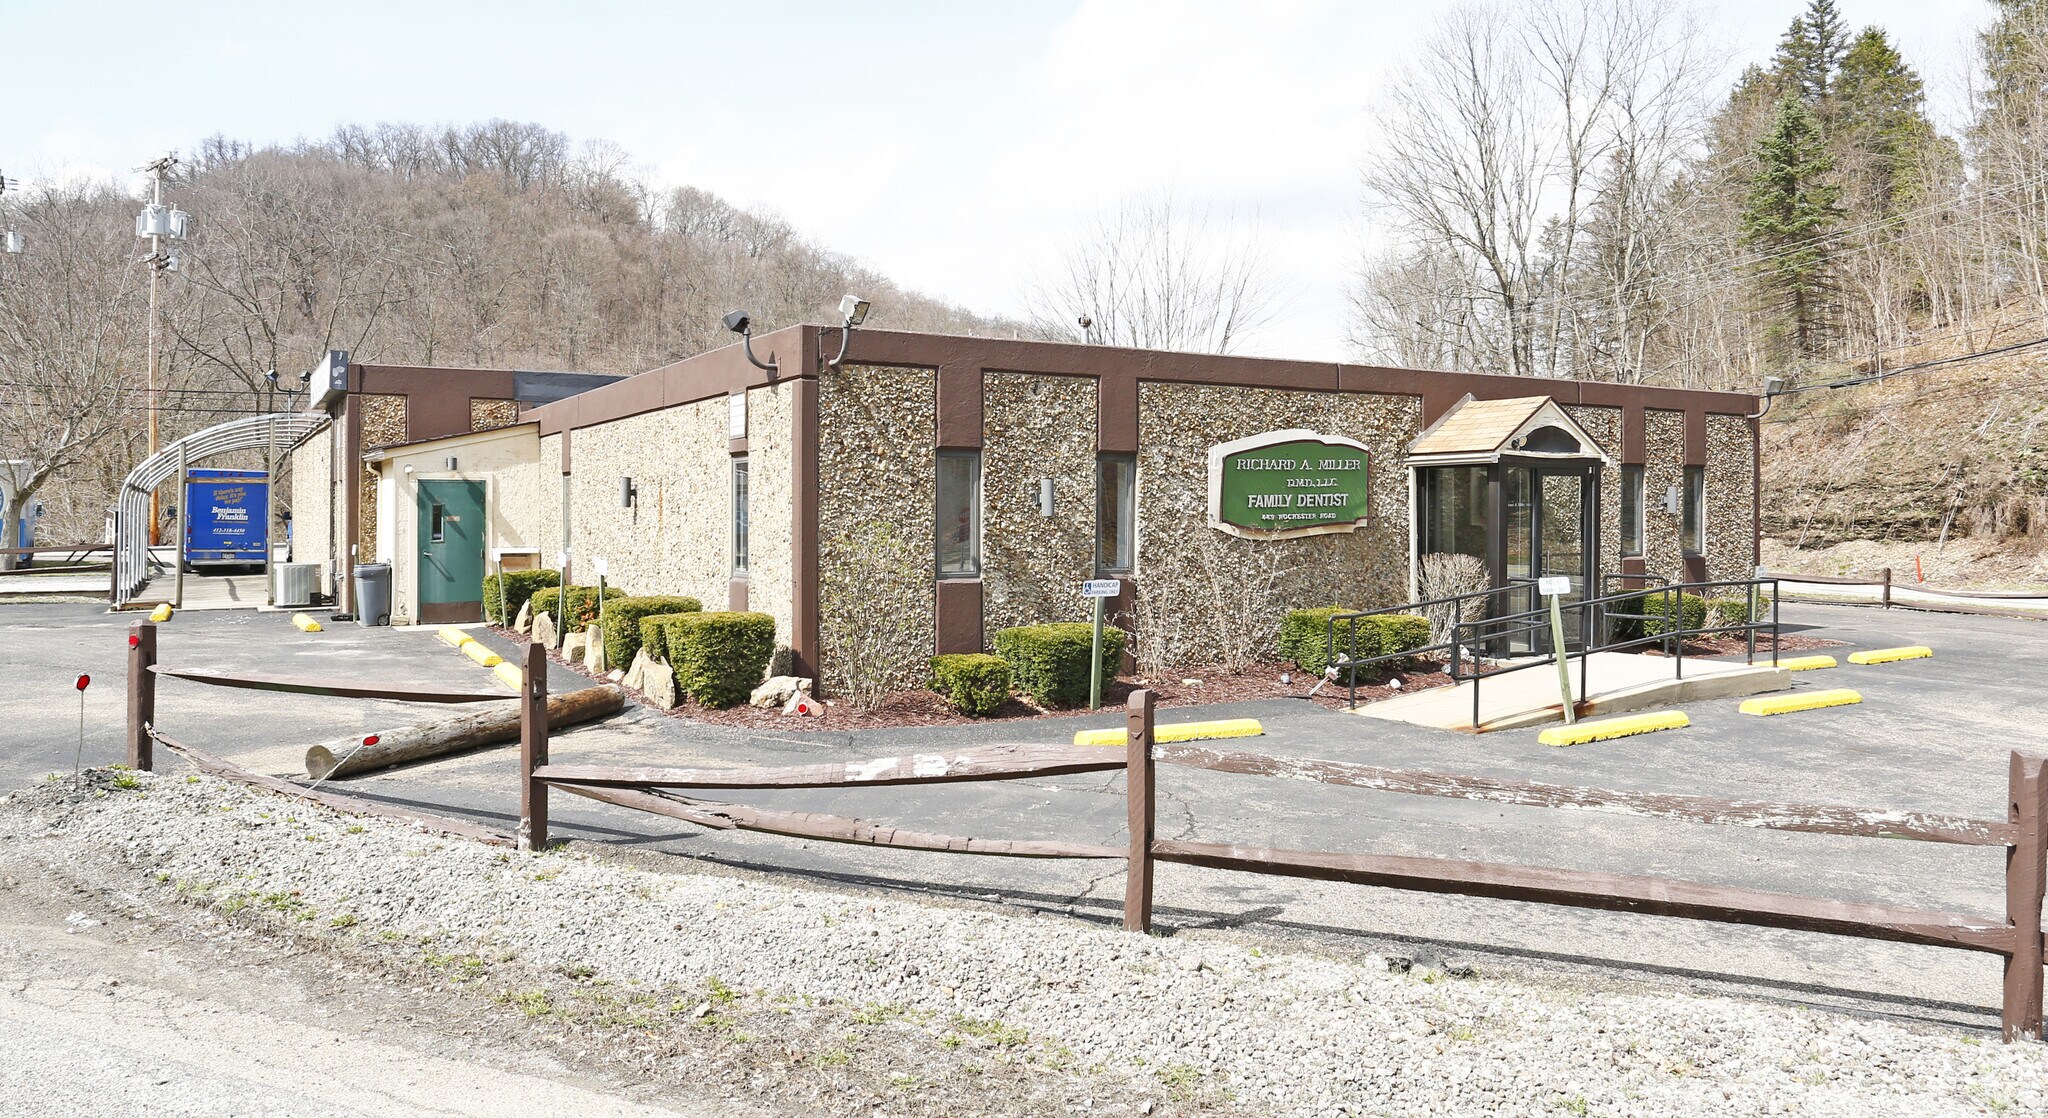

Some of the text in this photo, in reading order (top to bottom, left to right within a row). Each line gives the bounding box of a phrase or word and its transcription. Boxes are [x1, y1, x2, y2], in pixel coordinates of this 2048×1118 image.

[1236, 459, 1361, 470] RICHARD A. MILLER
[1247, 493, 1349, 508] FAMILY DENTIST
